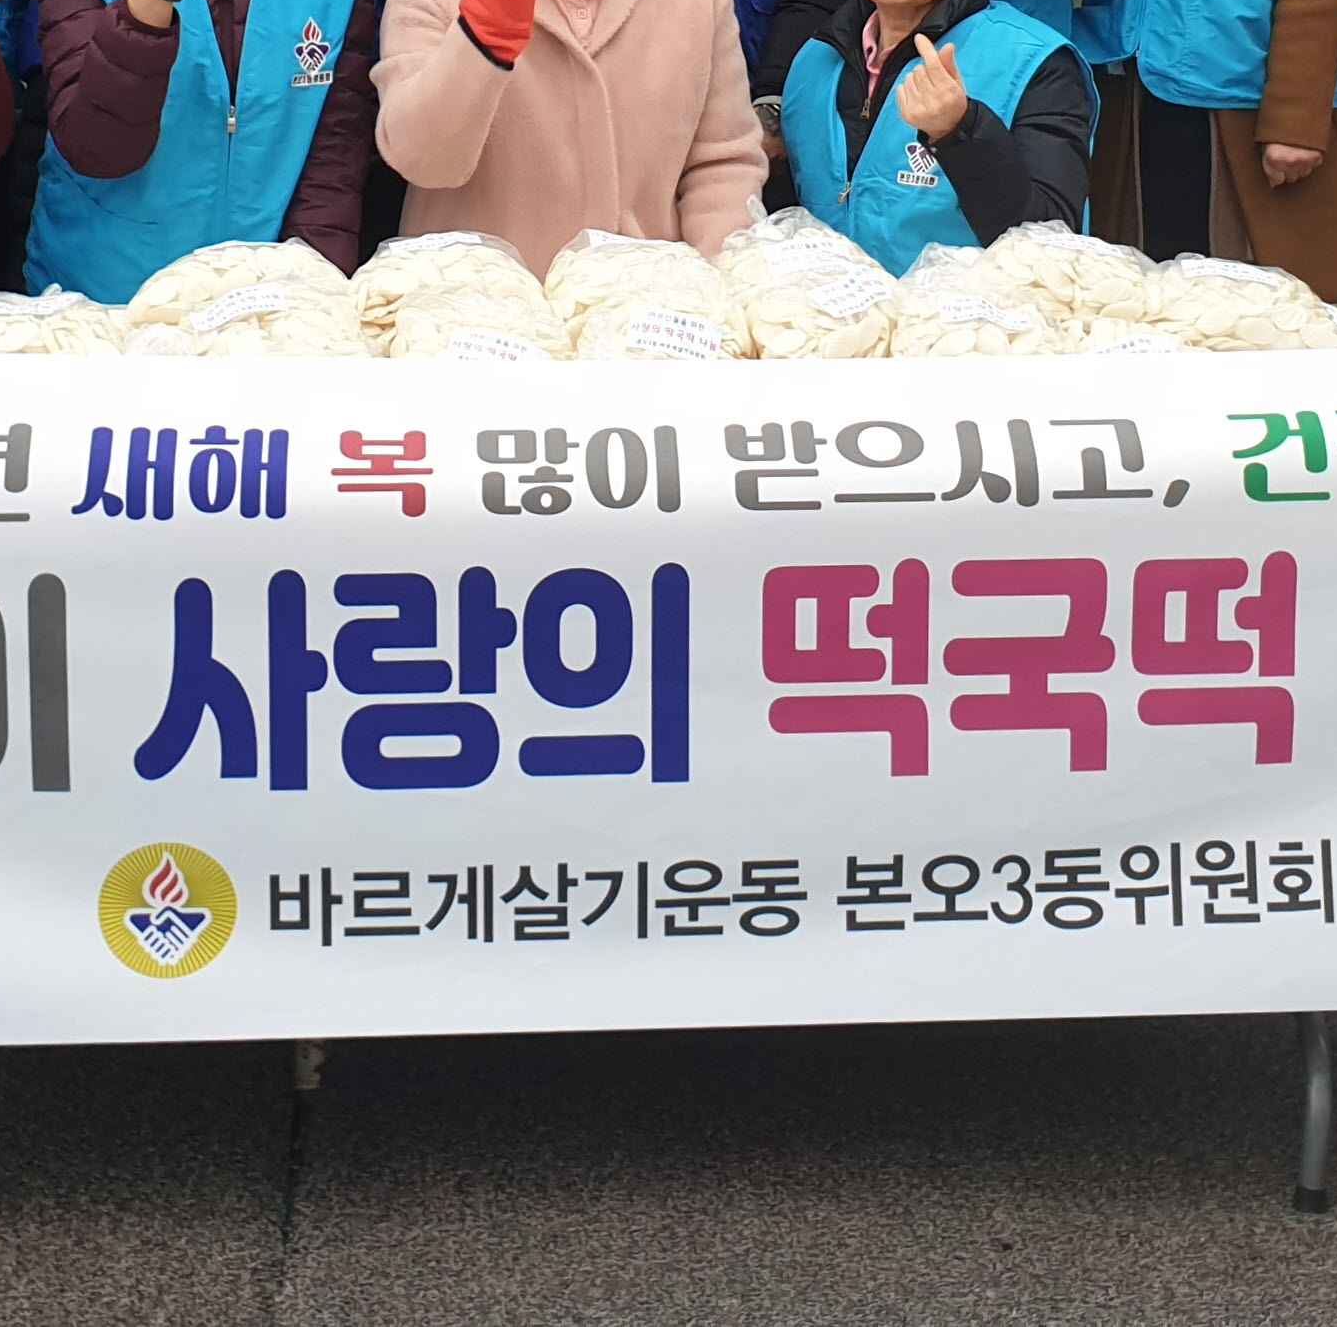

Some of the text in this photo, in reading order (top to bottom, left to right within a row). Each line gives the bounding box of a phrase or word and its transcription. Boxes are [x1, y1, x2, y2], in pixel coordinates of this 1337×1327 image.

[70, 425, 290, 521] 새해
[330, 430, 434, 518] 복
[476, 424, 681, 516] 많이
[723, 419, 1191, 511] 받으시고,
[133, 562, 690, 792] 사랑의
[761, 550, 1298, 777] 떡국떡
[268, 838, 1337, 947] 바르게살기운동 본오3동위원회
